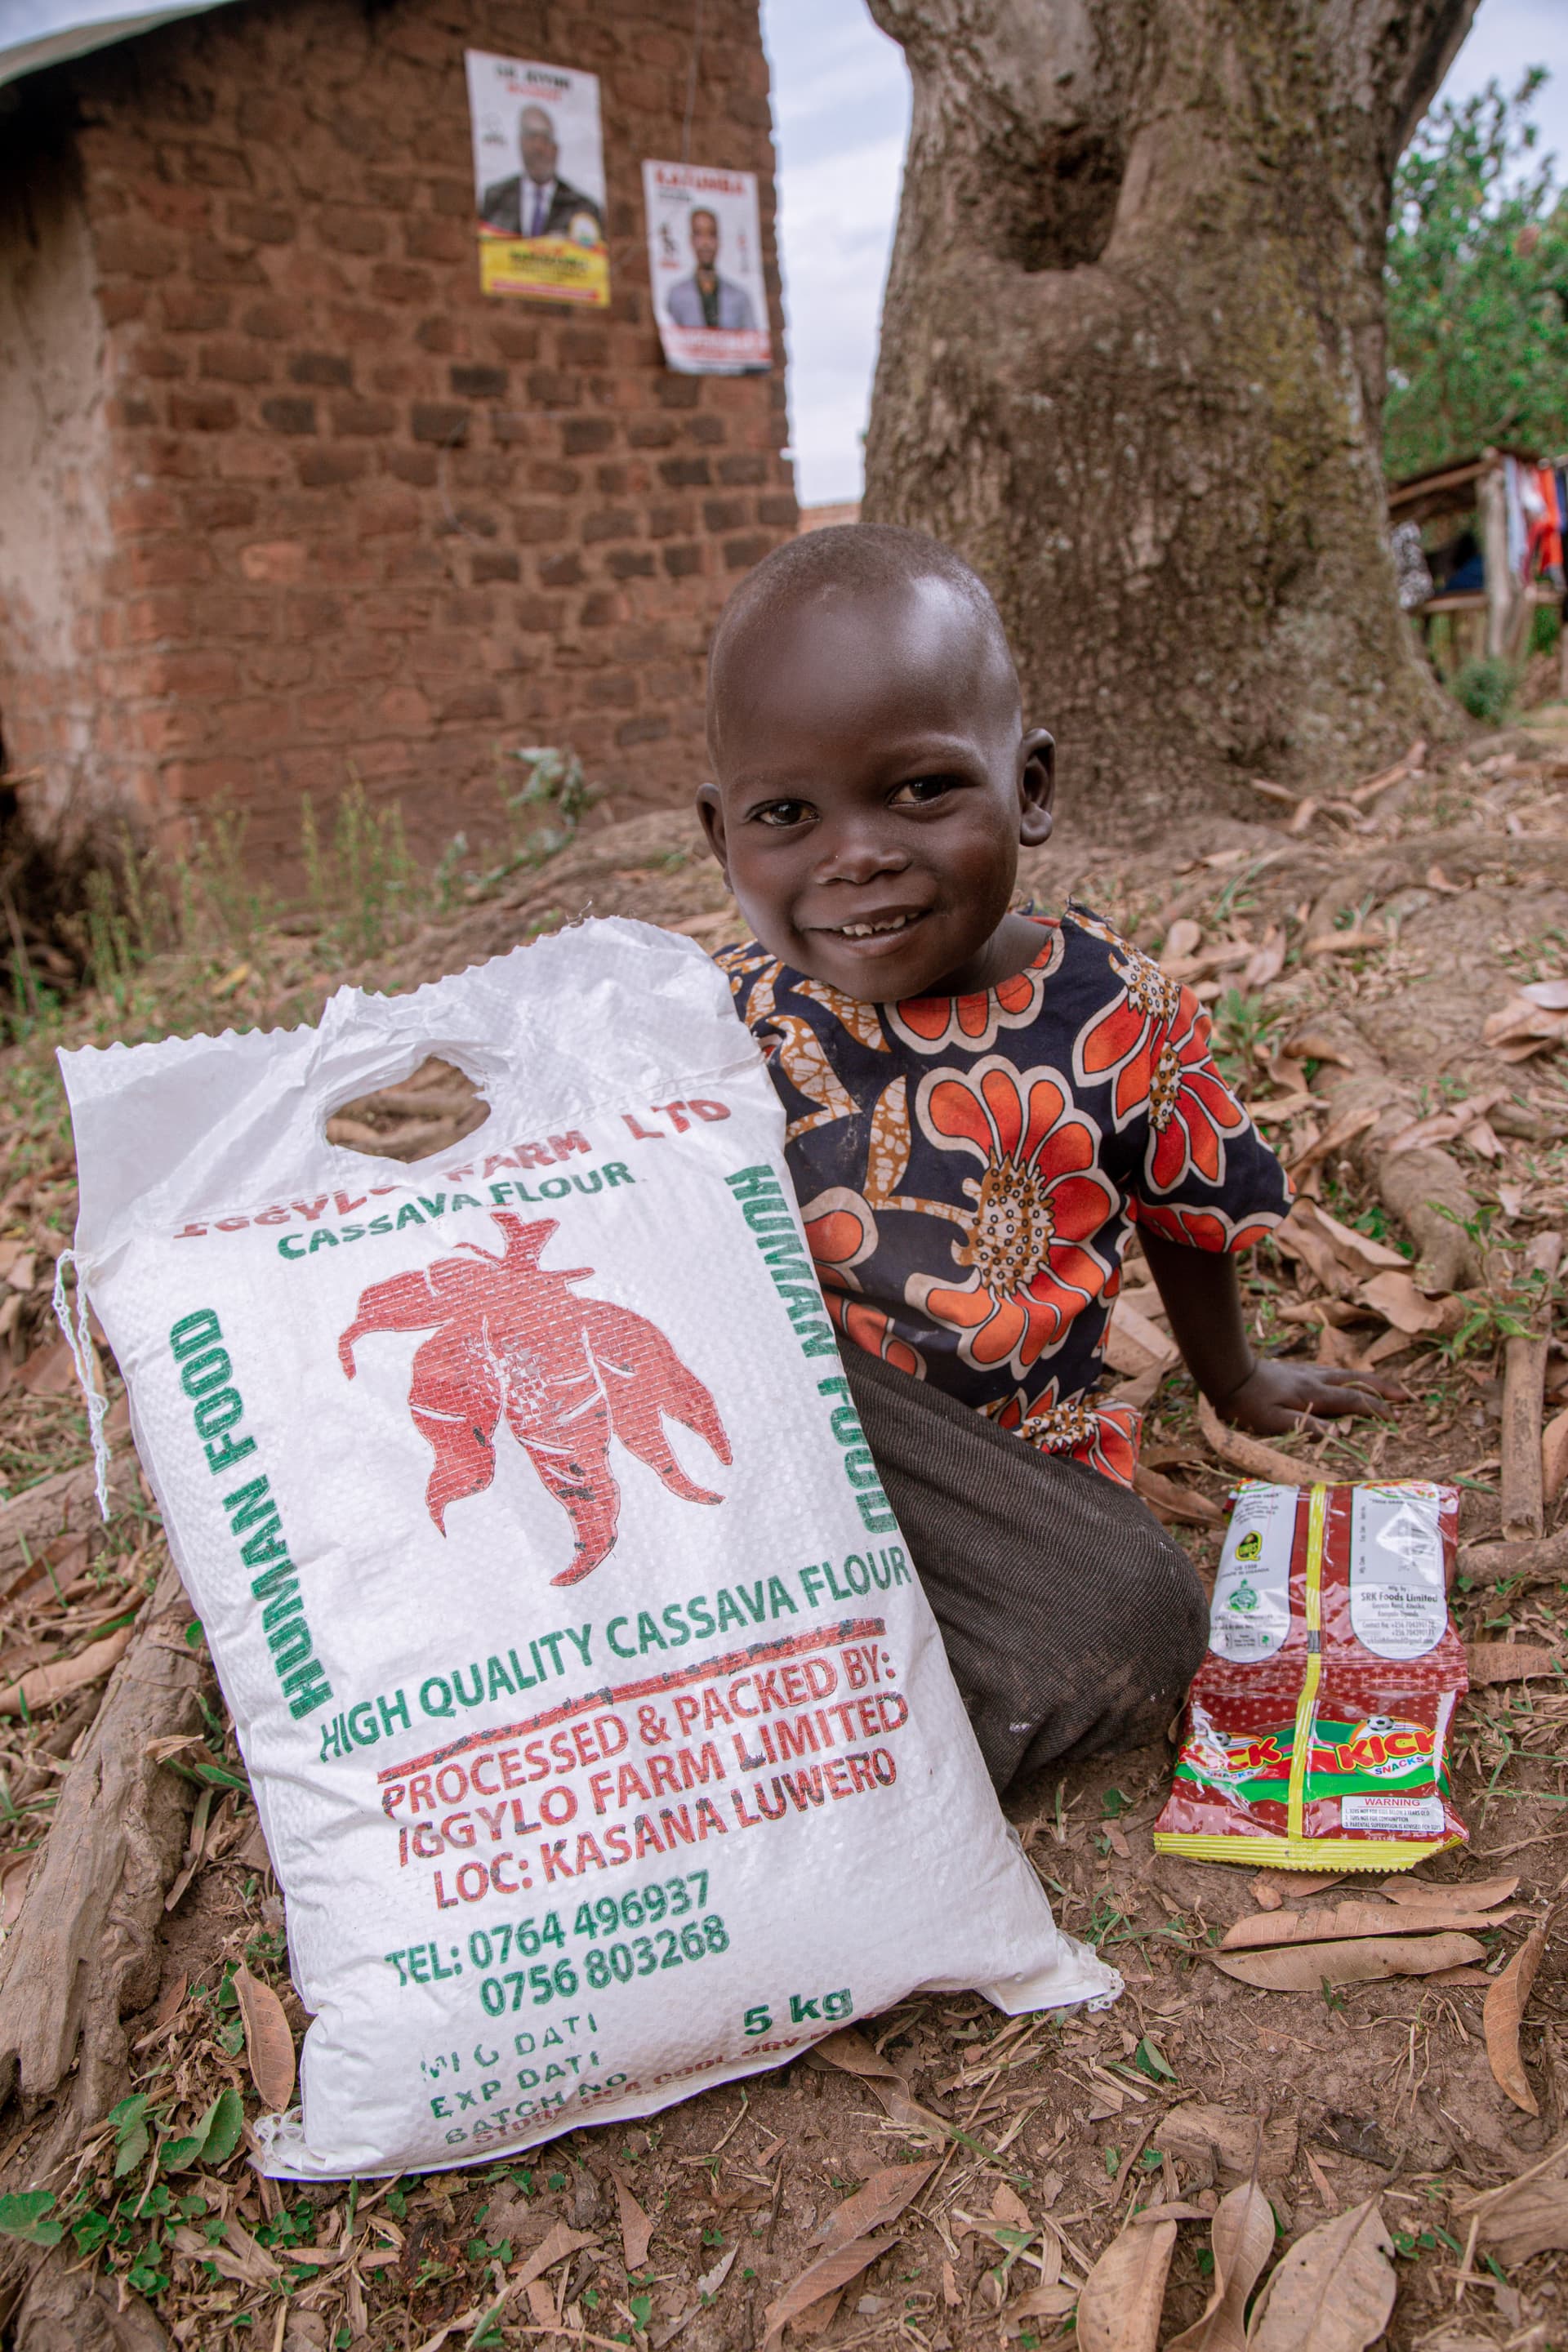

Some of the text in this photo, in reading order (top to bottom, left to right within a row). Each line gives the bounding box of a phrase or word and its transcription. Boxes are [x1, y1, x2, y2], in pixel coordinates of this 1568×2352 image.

[443, 1129, 593, 1183] FARM
[621, 1099, 731, 1140] LTD
[277, 1161, 635, 1261] CASSAVA FLOUR
[724, 1165, 898, 1535] HUMAN FOOD
[169, 1307, 334, 1722] HUMAN FOOD
[1361, 1592, 1438, 1602] SRK Foods Limited
[319, 1545, 911, 1764] HIGH QUALITY CASSAVA FLOUR
[381, 1643, 898, 1820] PROCESSED & PACKED BY:
[1206, 1770, 1254, 1780] SNACKS
[1335, 1730, 1449, 1771] KICK
[1374, 1756, 1425, 1775] SNACKS
[397, 1690, 910, 1868] IGGYLO FARM LIMITED
[1365, 1798, 1421, 1807] WARNING
[434, 1747, 898, 1912] LOC: KASANA LUWERO
[384, 1869, 710, 1987] TEL: 0764 496937
[479, 1914, 731, 2017] 0756 803268
[743, 2004, 773, 2036] 5
[789, 1988, 854, 2023] kg
[430, 2079, 501, 2119] EXP
[578, 2072, 628, 2097] NO
